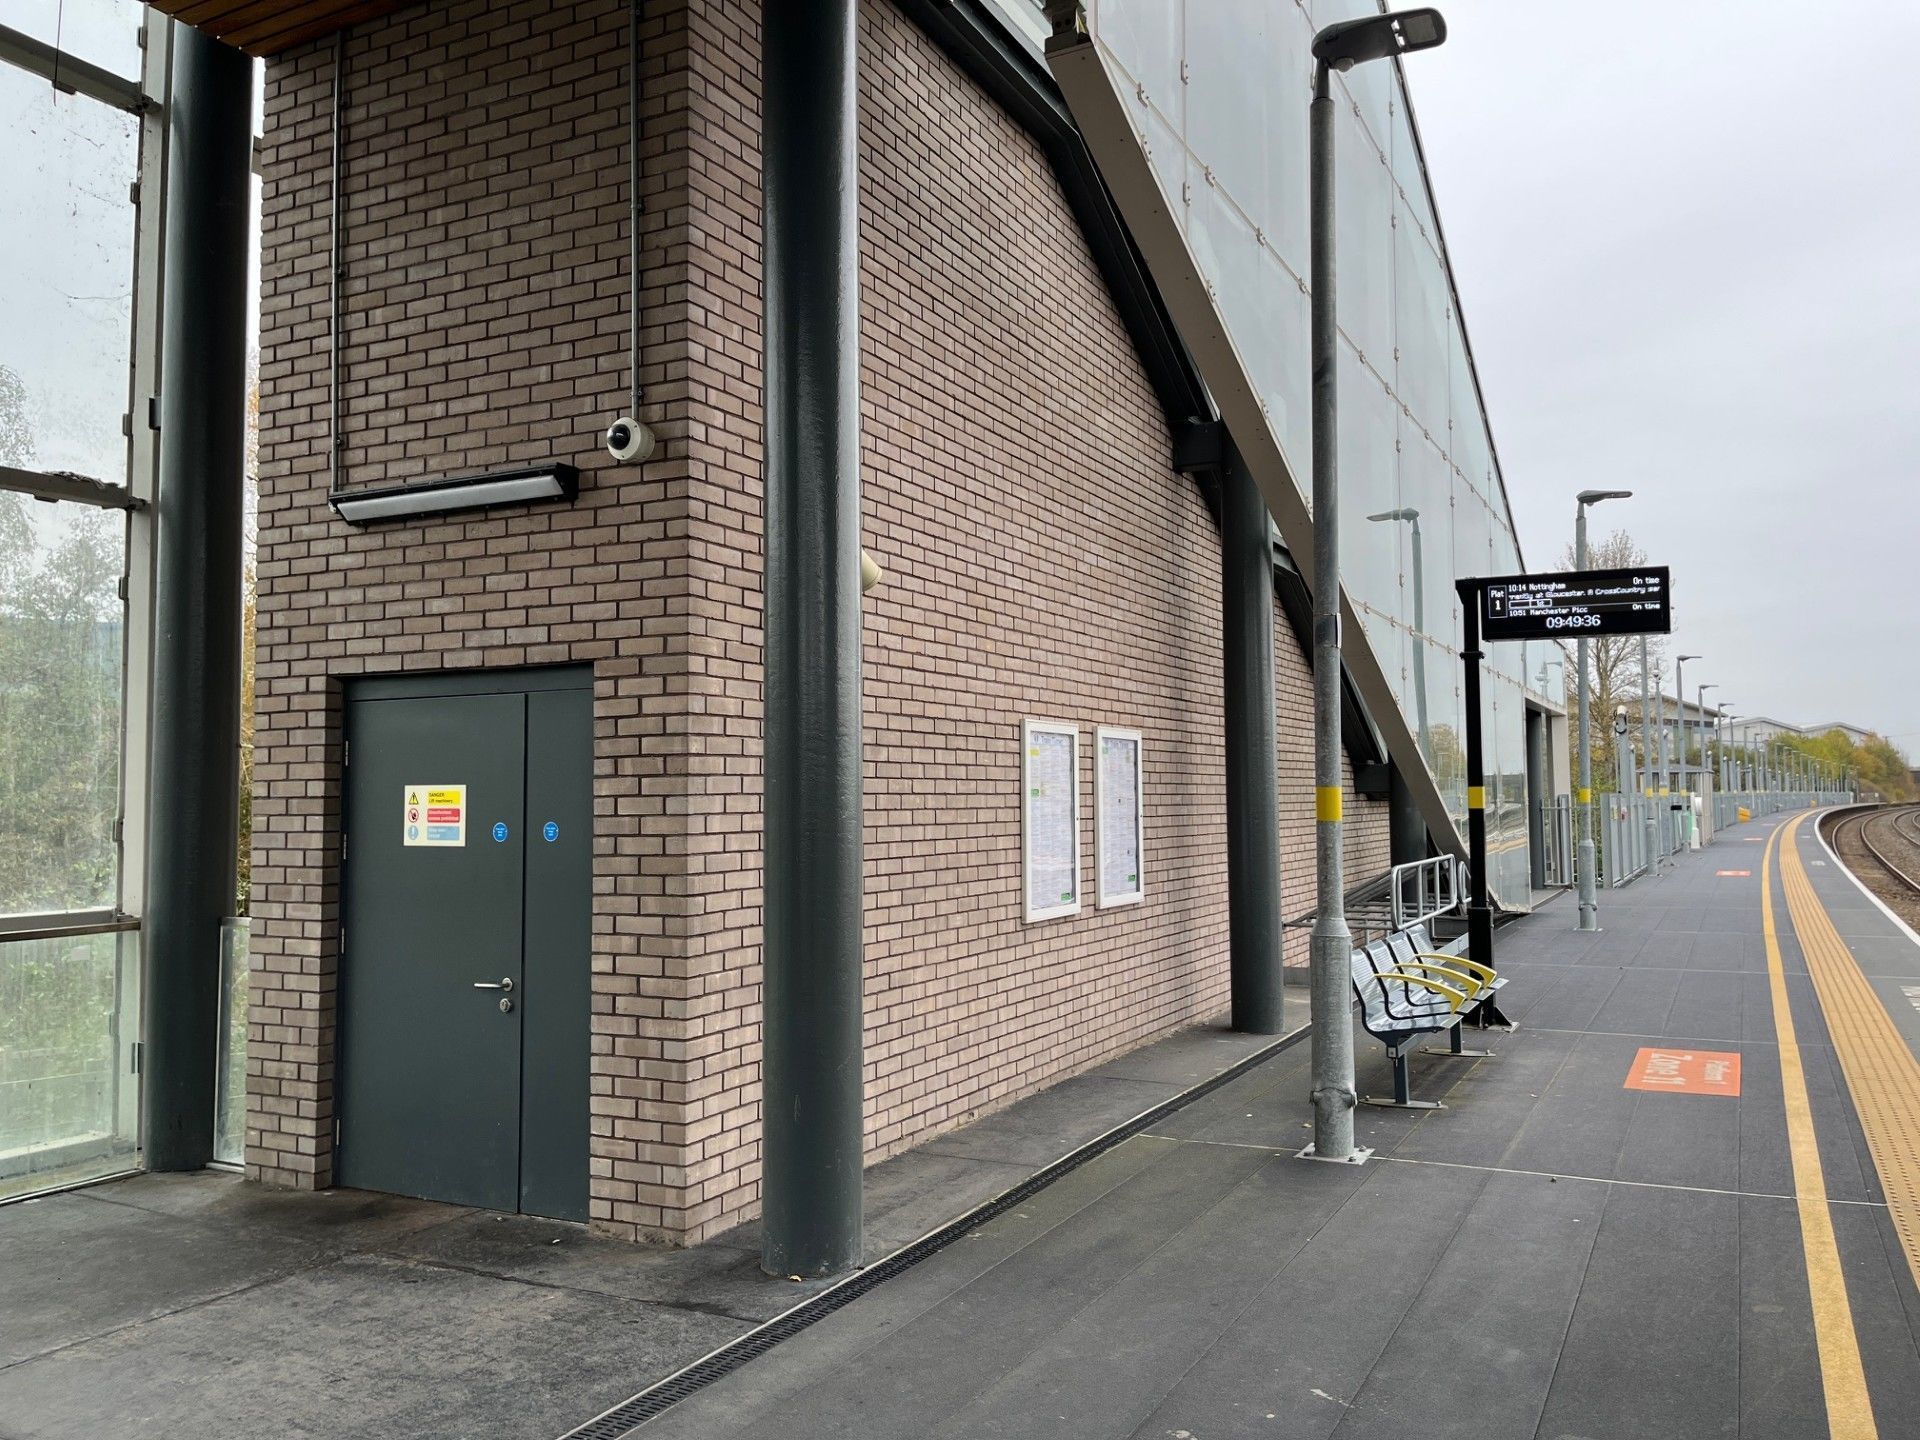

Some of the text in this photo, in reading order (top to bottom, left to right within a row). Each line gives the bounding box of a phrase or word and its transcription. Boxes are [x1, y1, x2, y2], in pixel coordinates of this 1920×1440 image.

[1632, 577, 1643, 585] On
[1509, 582, 1566, 592] 10:14 Nottingham
[1595, 587, 1646, 596] CrossCountry
[1491, 589, 1505, 598] Plat
[1495, 600, 1501, 610] 1
[1546, 614, 1601, 629] 09:49:36
[1641, 1053, 1693, 1085] Zone 11
